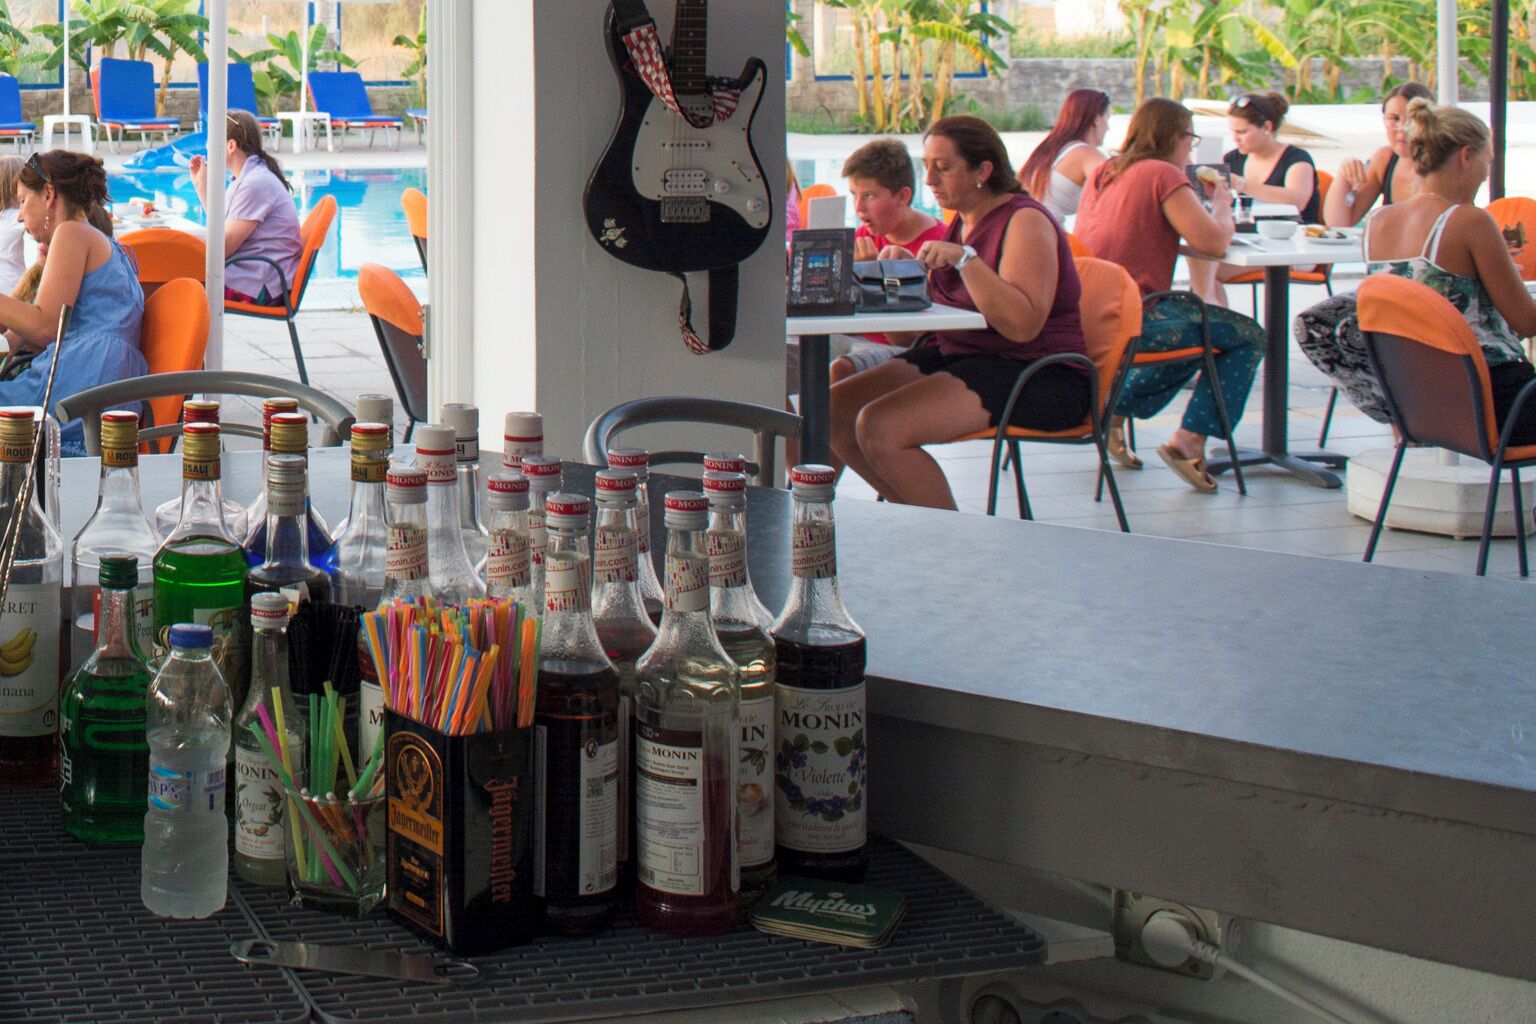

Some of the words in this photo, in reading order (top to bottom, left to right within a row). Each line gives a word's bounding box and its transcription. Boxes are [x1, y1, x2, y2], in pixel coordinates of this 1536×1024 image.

[393, 475, 426, 485] MONIN
[800, 473, 834, 482] MONIN
[495, 480, 529, 491] MONIN
[781, 708, 862, 730] MONIN
[651, 746, 698, 760] MONIN
[797, 765, 847, 785] Violette
[770, 890, 877, 917] Mythos
